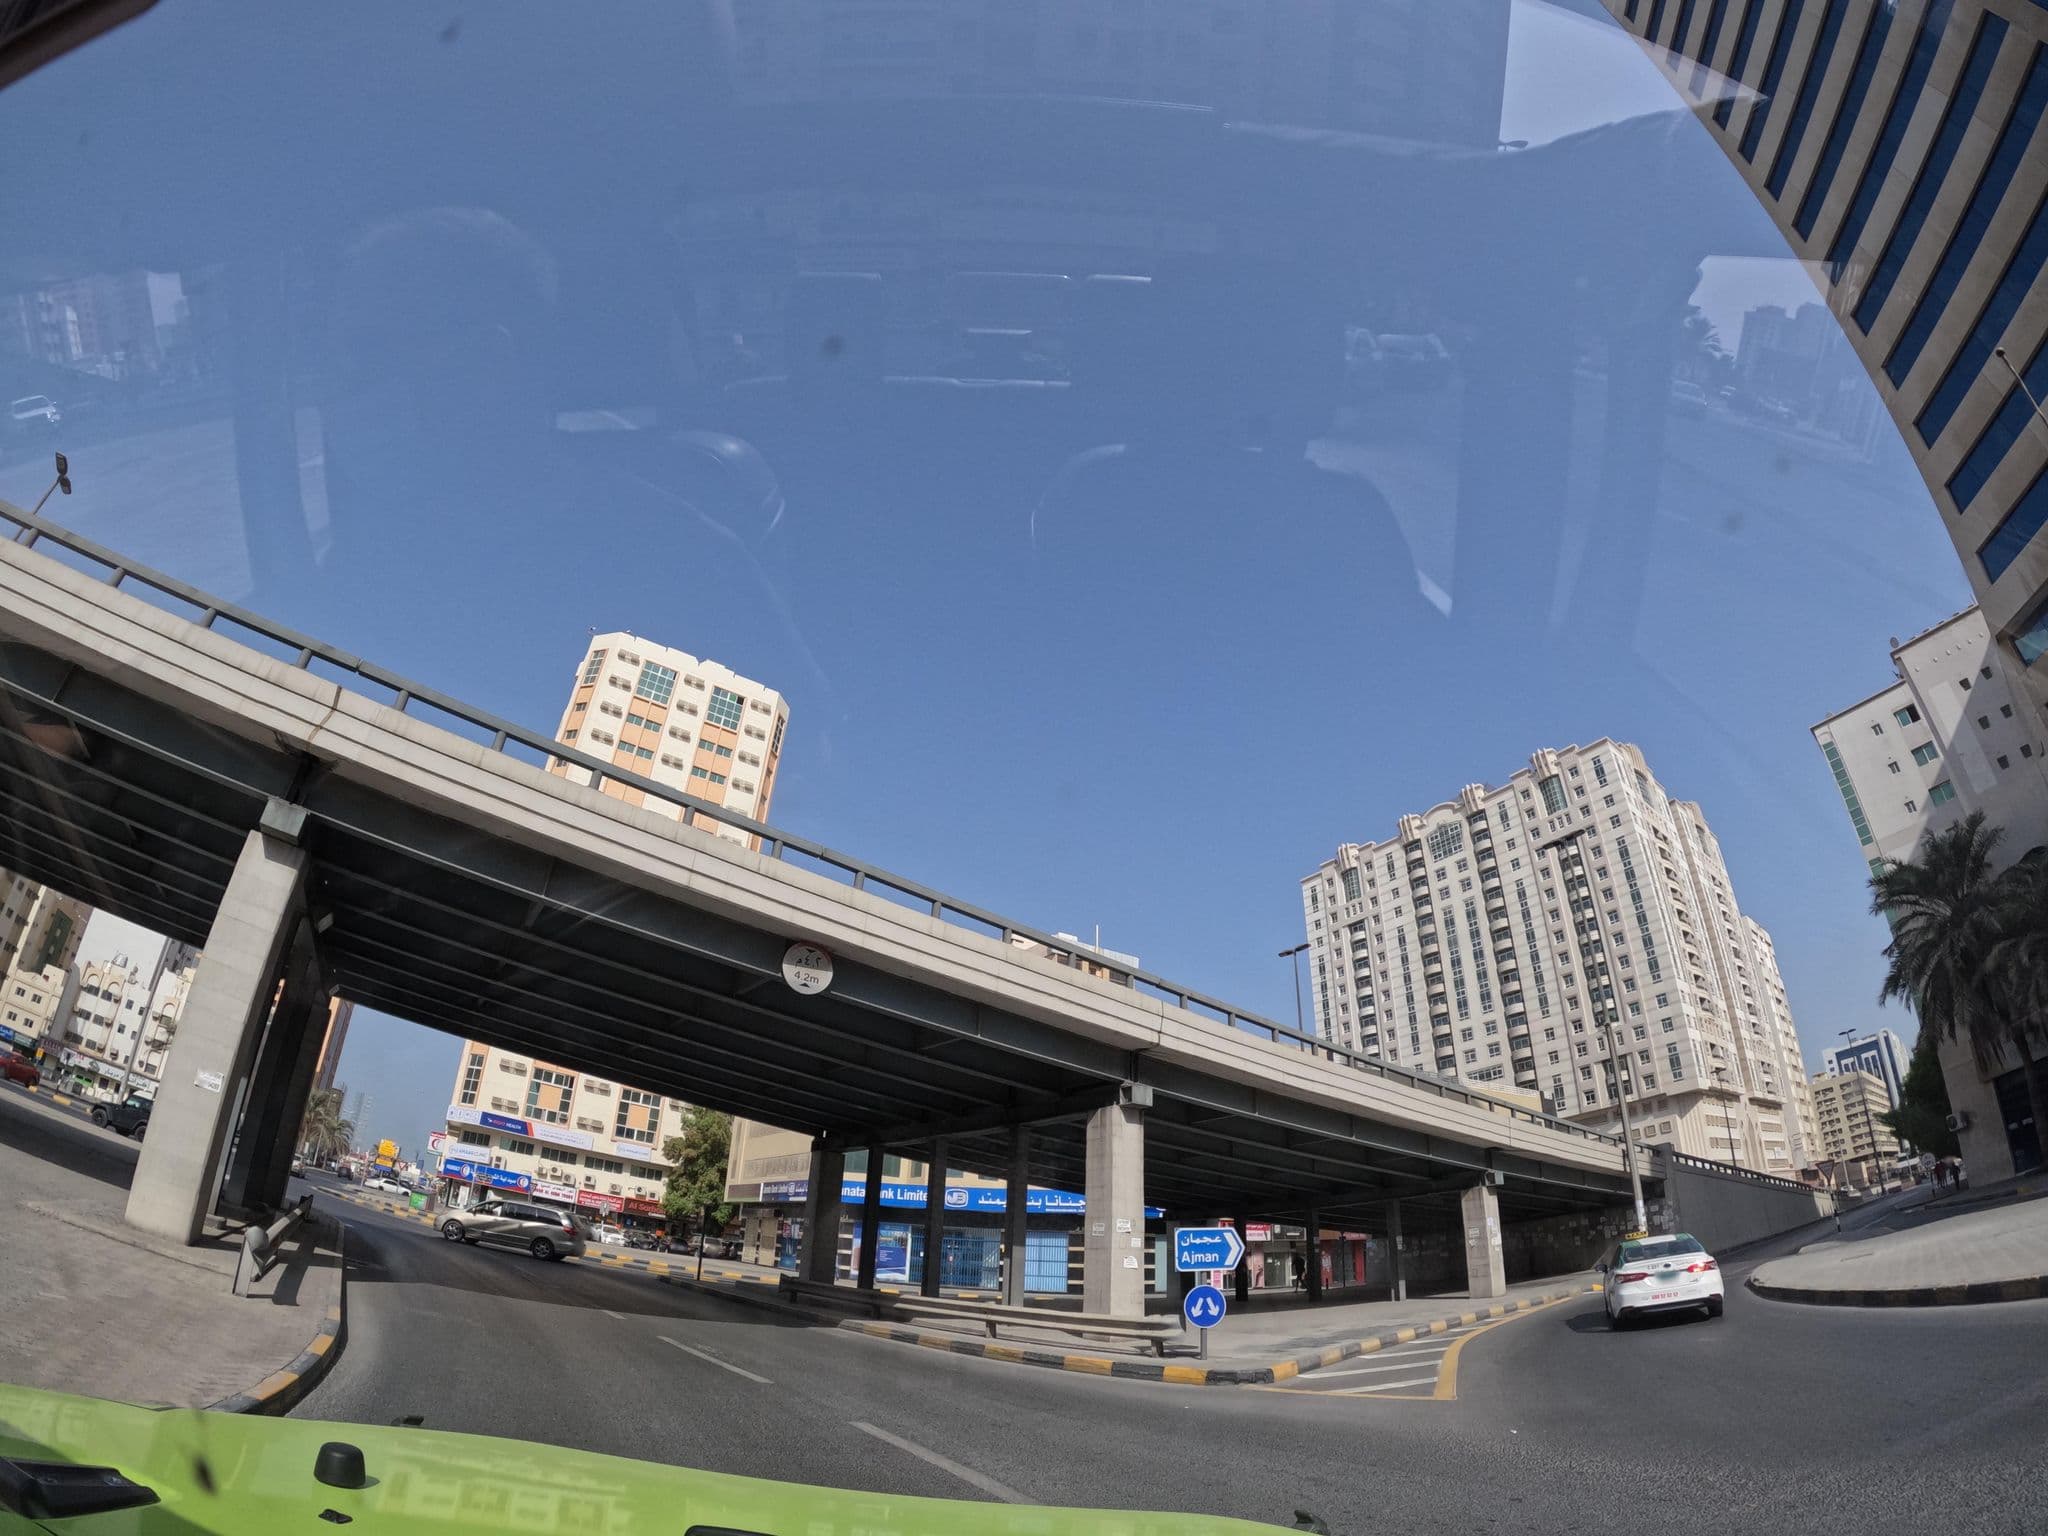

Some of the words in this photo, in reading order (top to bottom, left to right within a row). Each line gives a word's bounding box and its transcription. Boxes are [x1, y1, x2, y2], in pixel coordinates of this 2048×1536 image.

[794, 971, 819, 984] 4.2m
[842, 1187, 866, 1197] nata
[880, 1188, 895, 1199] nk
[897, 1189, 928, 1202] Limite
[1027, 1196, 1042, 1208] بن
[1181, 1232, 1222, 1246] عجمان
[1181, 1250, 1219, 1265] Ajman
